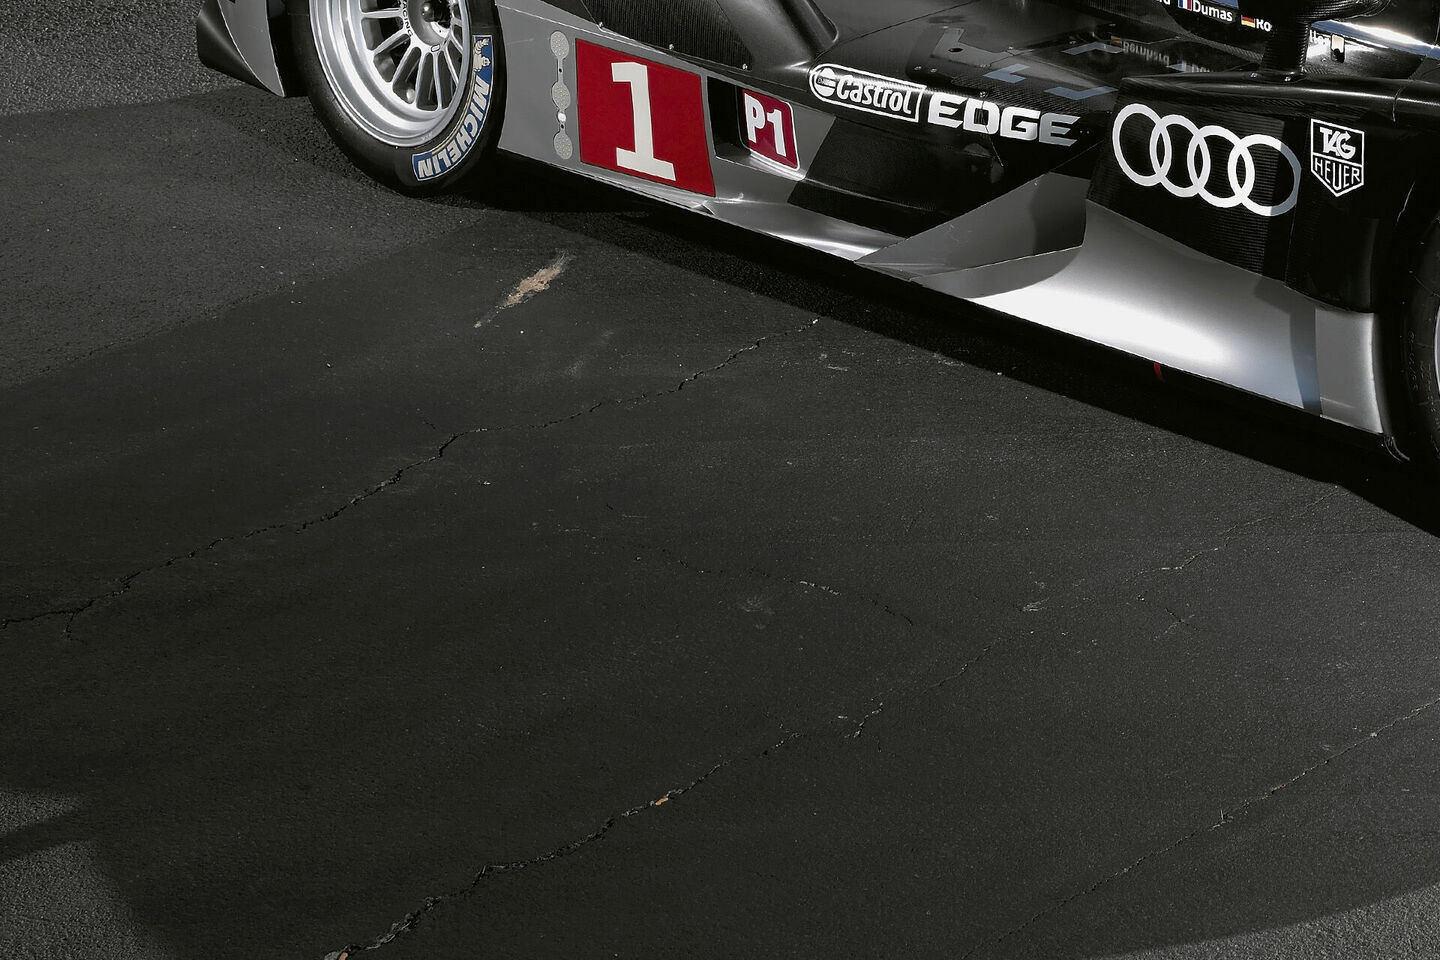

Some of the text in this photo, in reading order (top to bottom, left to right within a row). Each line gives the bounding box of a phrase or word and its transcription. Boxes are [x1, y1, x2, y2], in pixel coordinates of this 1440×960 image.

[1192, 0, 1233, 22] Dumas
[417, 74, 491, 178] MICHELIN
[611, 62, 677, 181] 1
[745, 101, 786, 157] P1
[836, 74, 1081, 148] Castrol EDGE
[1319, 126, 1356, 160] TAG
[1314, 157, 1361, 191] HEUER
